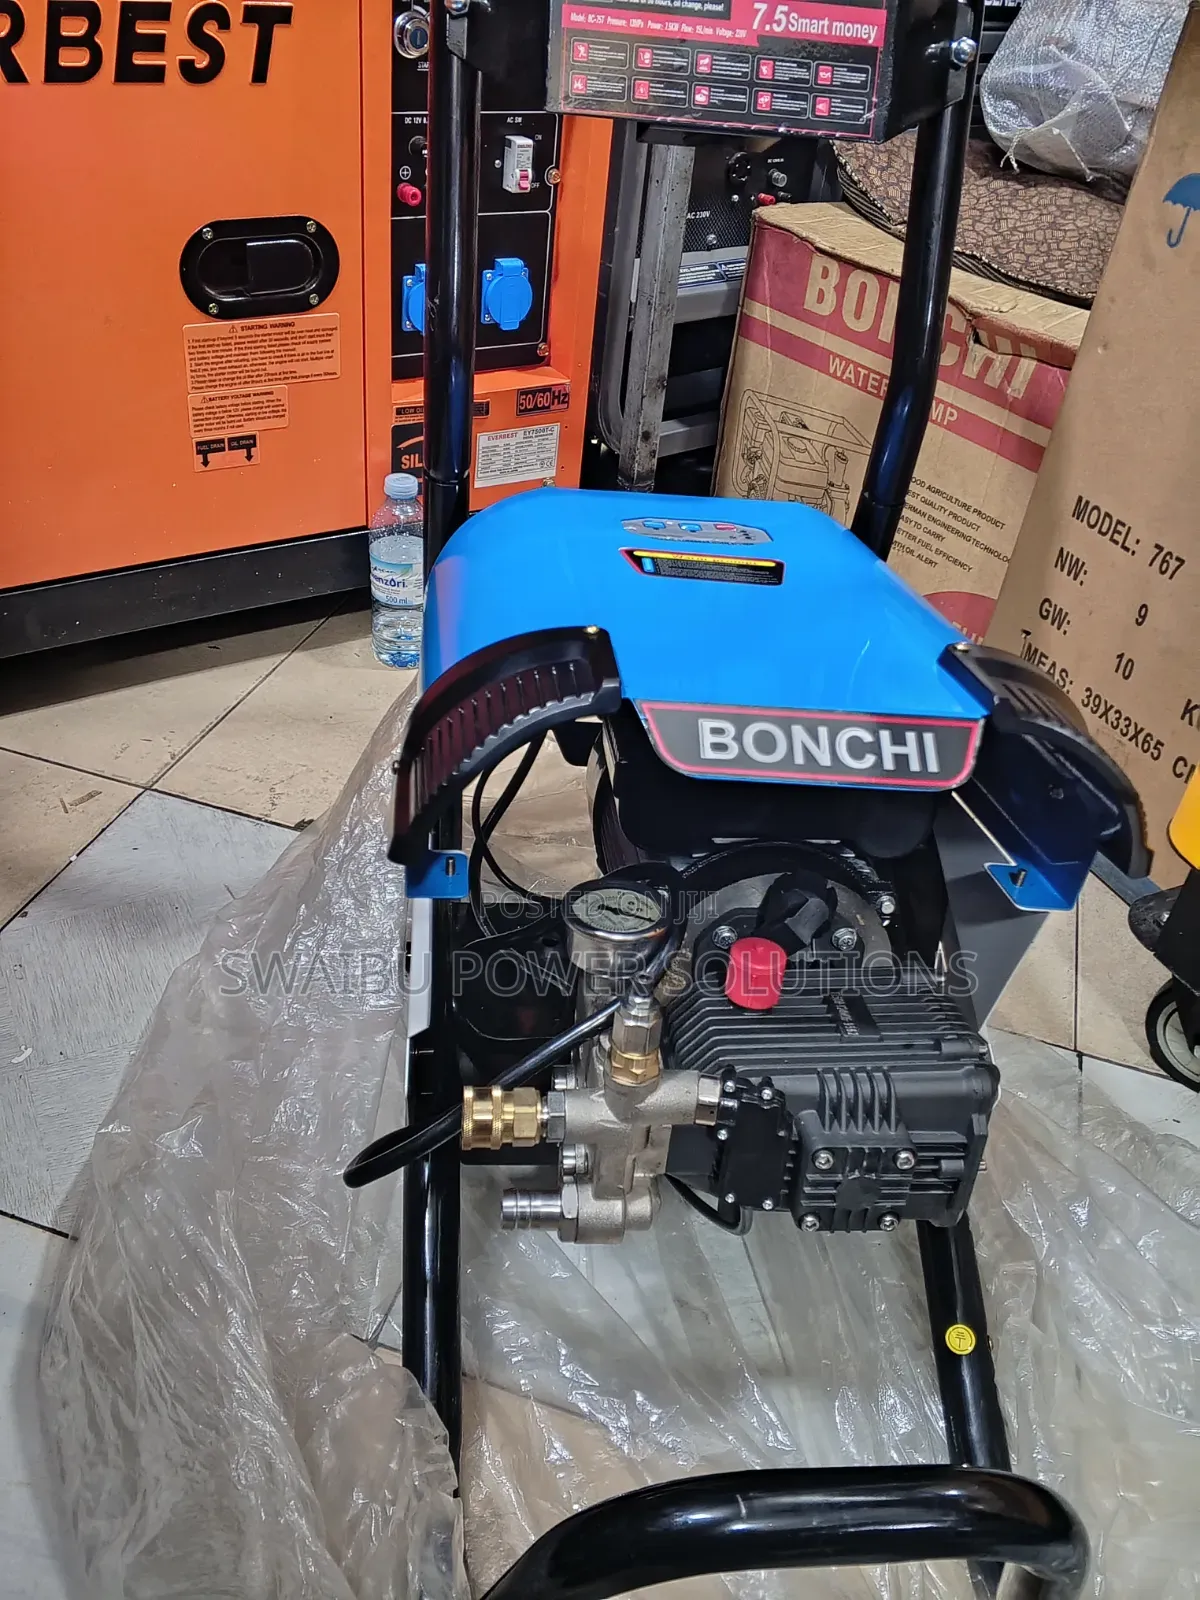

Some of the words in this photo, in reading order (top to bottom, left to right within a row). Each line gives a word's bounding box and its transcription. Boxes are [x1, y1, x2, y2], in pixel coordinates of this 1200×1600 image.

[752, 2, 789, 32] 7.5
[788, 12, 829, 35] Smart
[832, 21, 878, 43] money
[487, 432, 518, 441] EVERBEST
[401, 453, 423, 469] SIL
[904, 503, 927, 519] ERMAN
[927, 514, 971, 542] ENGINEERING
[907, 490, 919, 501] EST
[920, 496, 947, 514] QUALITY
[948, 511, 981, 532] PRODUCT
[909, 476, 926, 488] OOD
[926, 485, 972, 512] AGRICULTURE
[973, 508, 1006, 530] PRODUCT
[896, 527, 918, 543] ETTER
[917, 538, 934, 552] FUEL
[934, 548, 973, 573] EFFICIENCY
[900, 515, 913, 526] ASY
[913, 521, 922, 530] TO
[922, 526, 946, 543] CARRY
[1071, 494, 1141, 557] MODEL:
[1148, 543, 1186, 581] 767
[905, 547, 915, 557] OIL
[916, 553, 938, 569] ALERT
[385, 595, 398, 604] 500
[1054, 545, 1089, 586] NW:
[1135, 602, 1149, 626] 9
[1038, 597, 1072, 635] GW:
[1114, 651, 1135, 681] 10
[1081, 686, 1164, 761] 39X33X65
[698, 718, 941, 773] BONCHI
